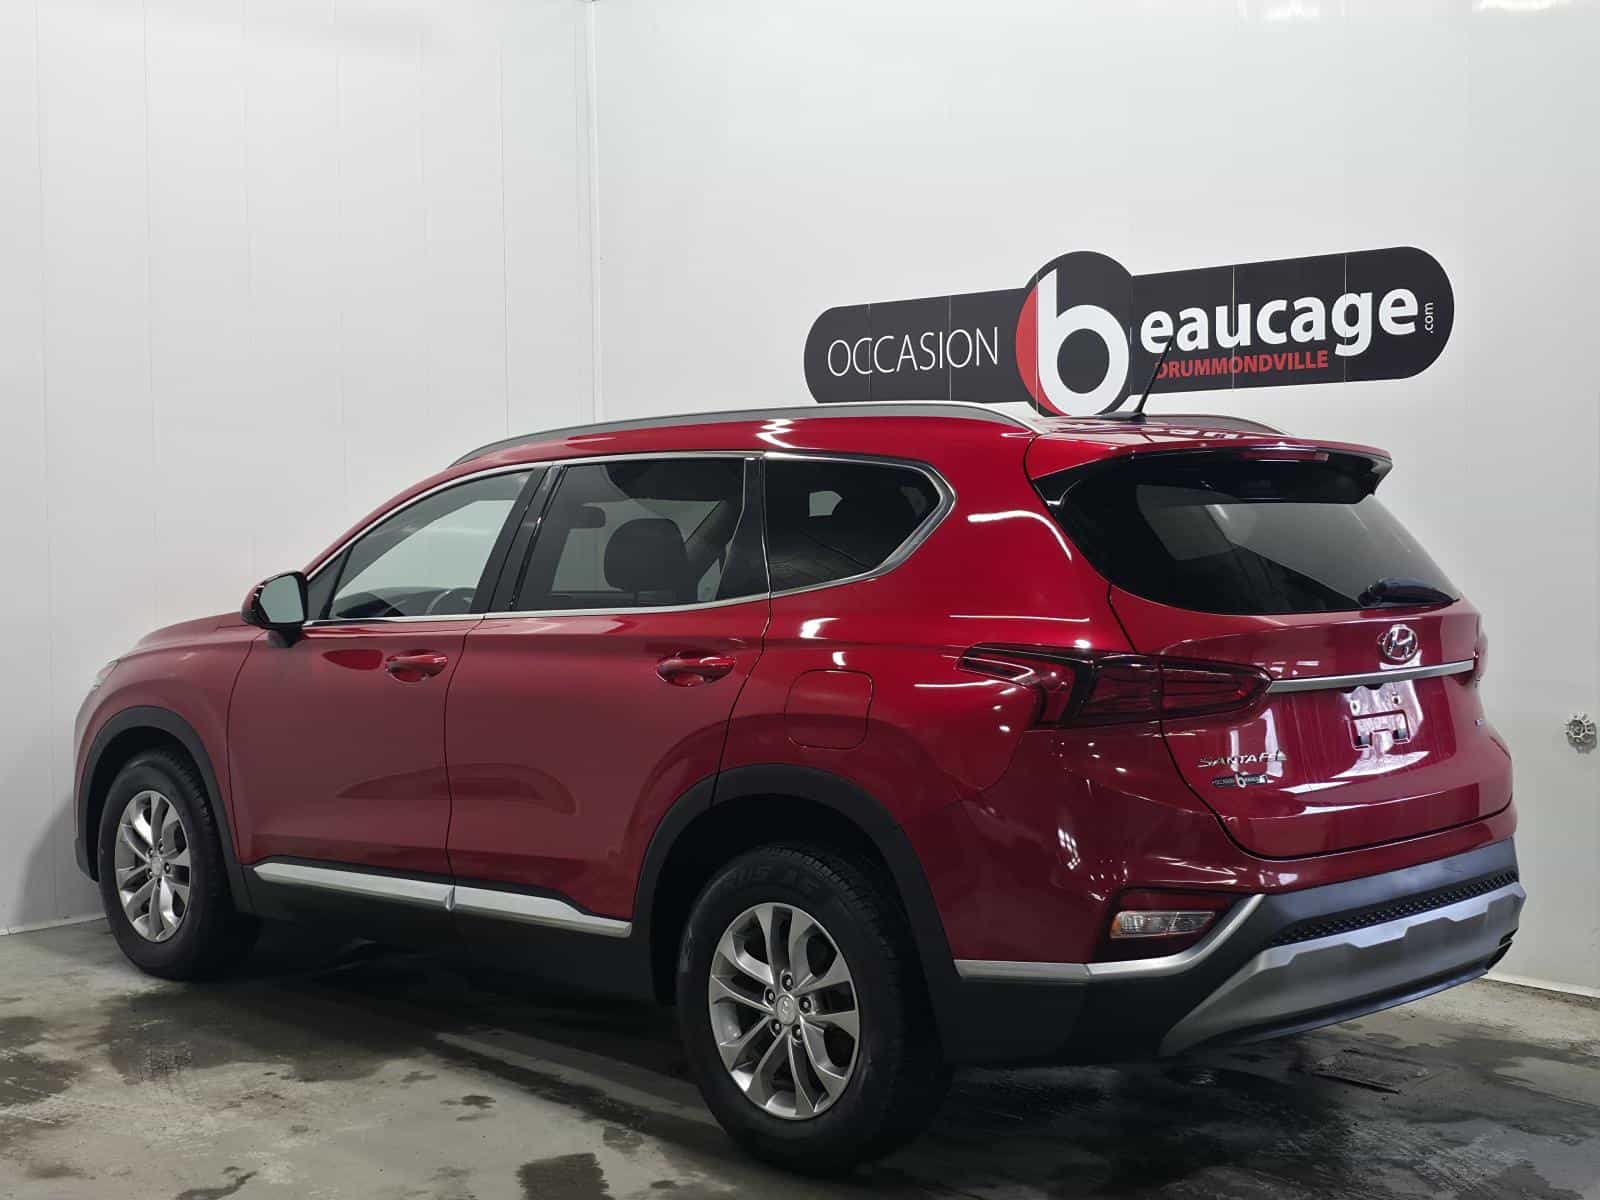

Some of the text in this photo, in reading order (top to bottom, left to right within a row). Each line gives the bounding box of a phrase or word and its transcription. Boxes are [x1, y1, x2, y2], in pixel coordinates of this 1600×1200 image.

[1424, 302, 1434, 334] .com
[827, 326, 998, 377] OCCASION
[1154, 350, 1329, 380] DRUMMONDVILLE
